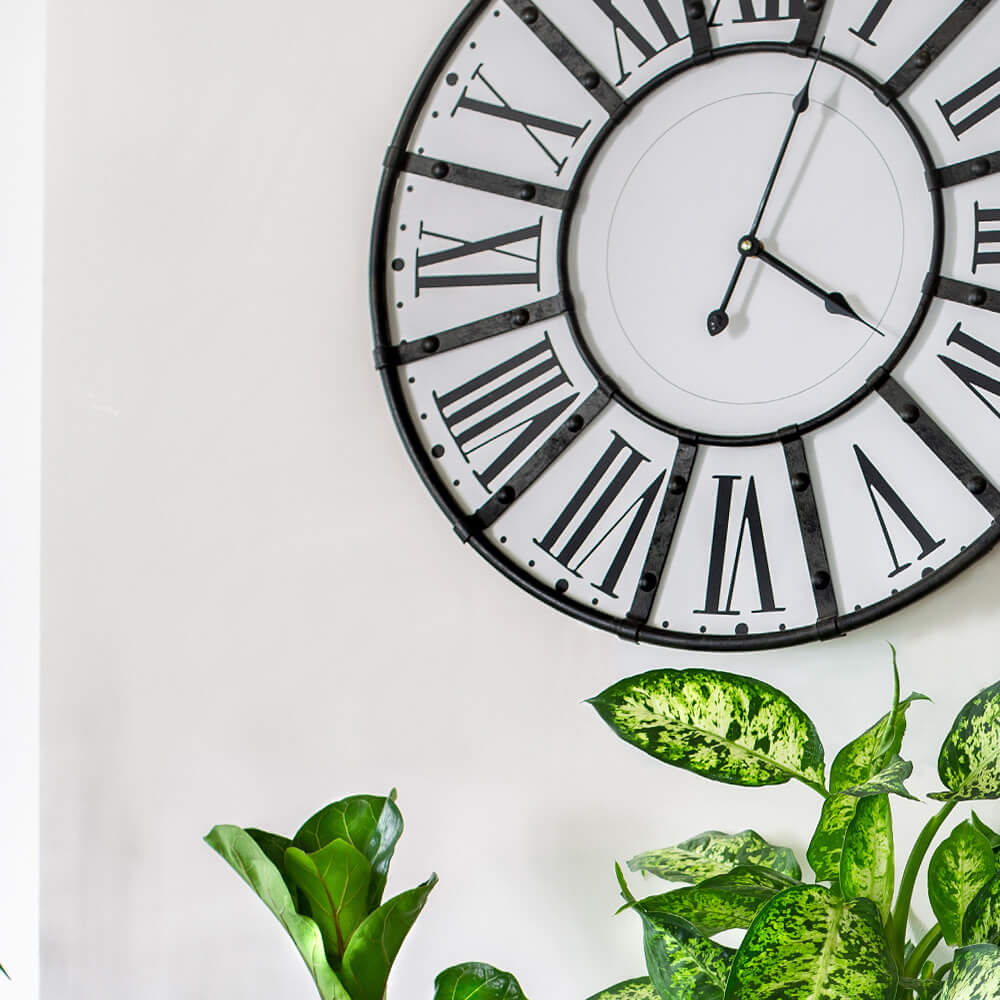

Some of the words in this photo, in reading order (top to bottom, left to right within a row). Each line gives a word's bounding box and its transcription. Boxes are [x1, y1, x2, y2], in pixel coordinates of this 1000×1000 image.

[451, 64, 591, 176] X
[415, 216, 543, 297] IX
[432, 331, 580, 494] VIII
[533, 430, 666, 598] VII
[693, 475, 786, 615] VI
[853, 444, 945, 577] V
